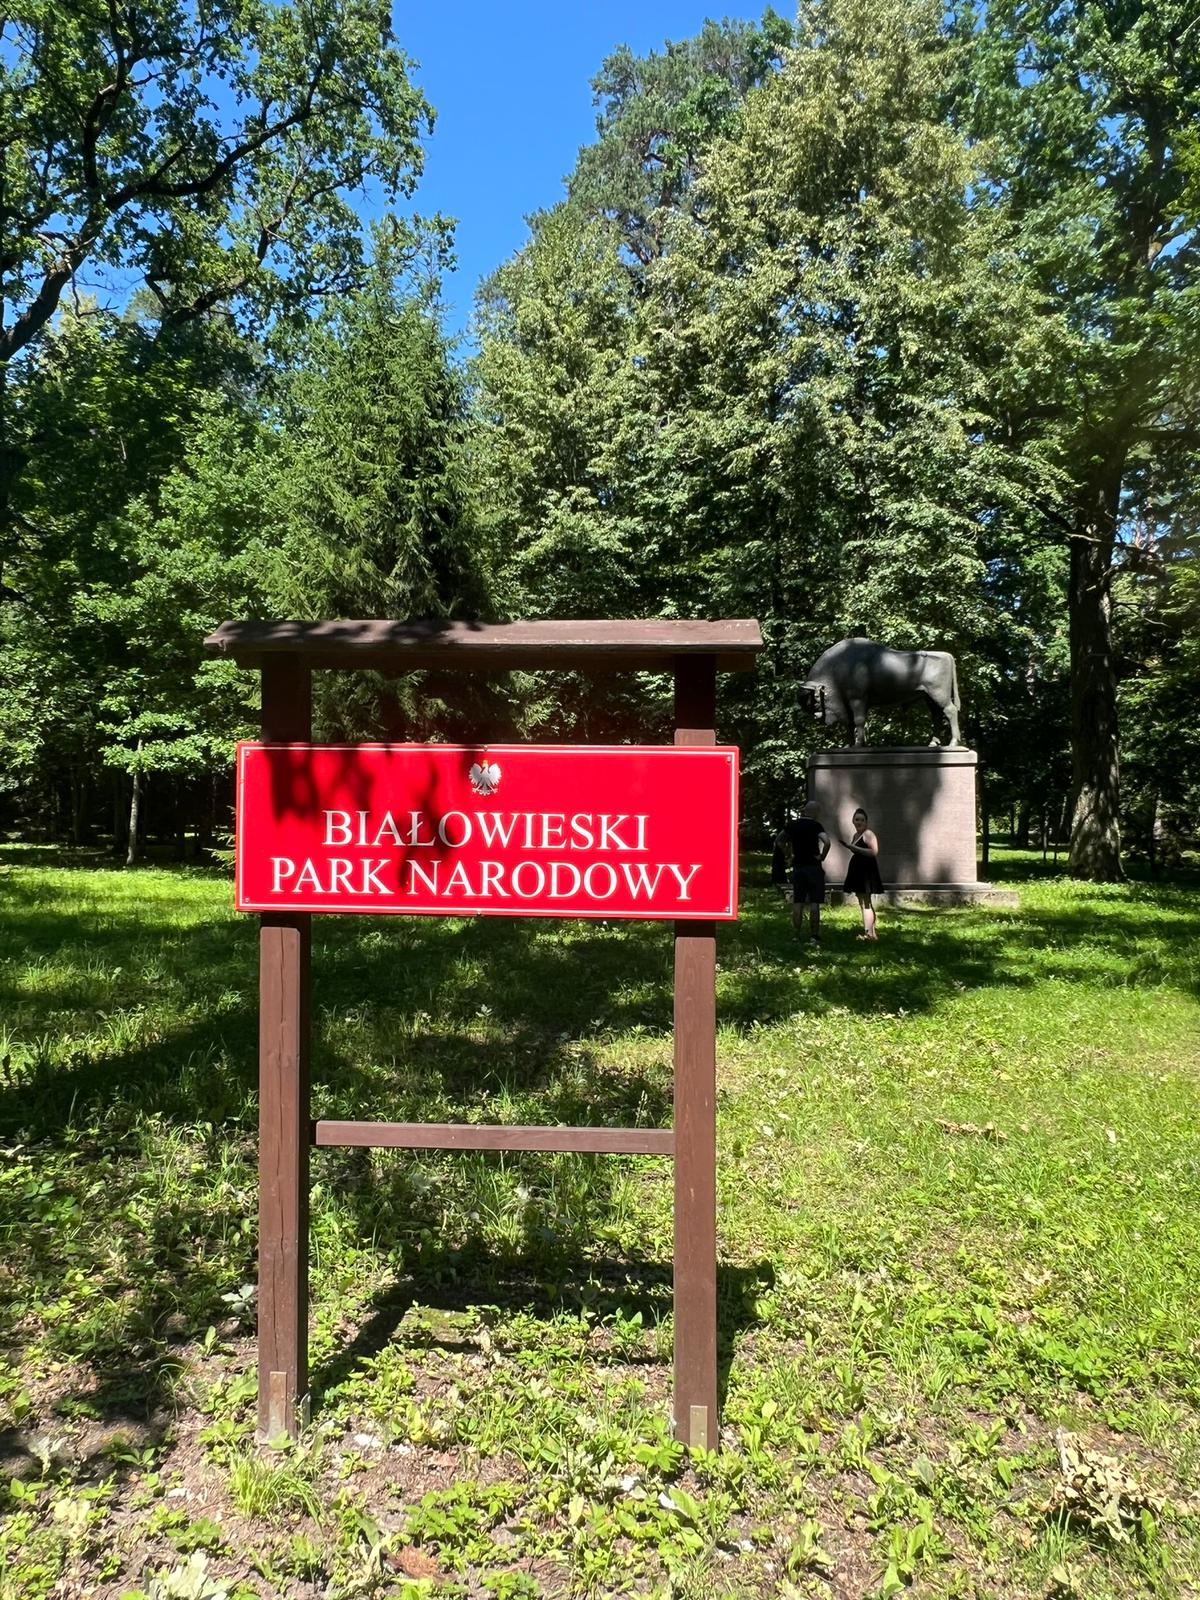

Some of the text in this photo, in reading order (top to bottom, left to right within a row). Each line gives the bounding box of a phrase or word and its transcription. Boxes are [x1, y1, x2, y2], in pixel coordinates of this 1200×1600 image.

[322, 810, 649, 851] BIAŁOWIESKI
[270, 857, 702, 901] PARK NARODOWY
